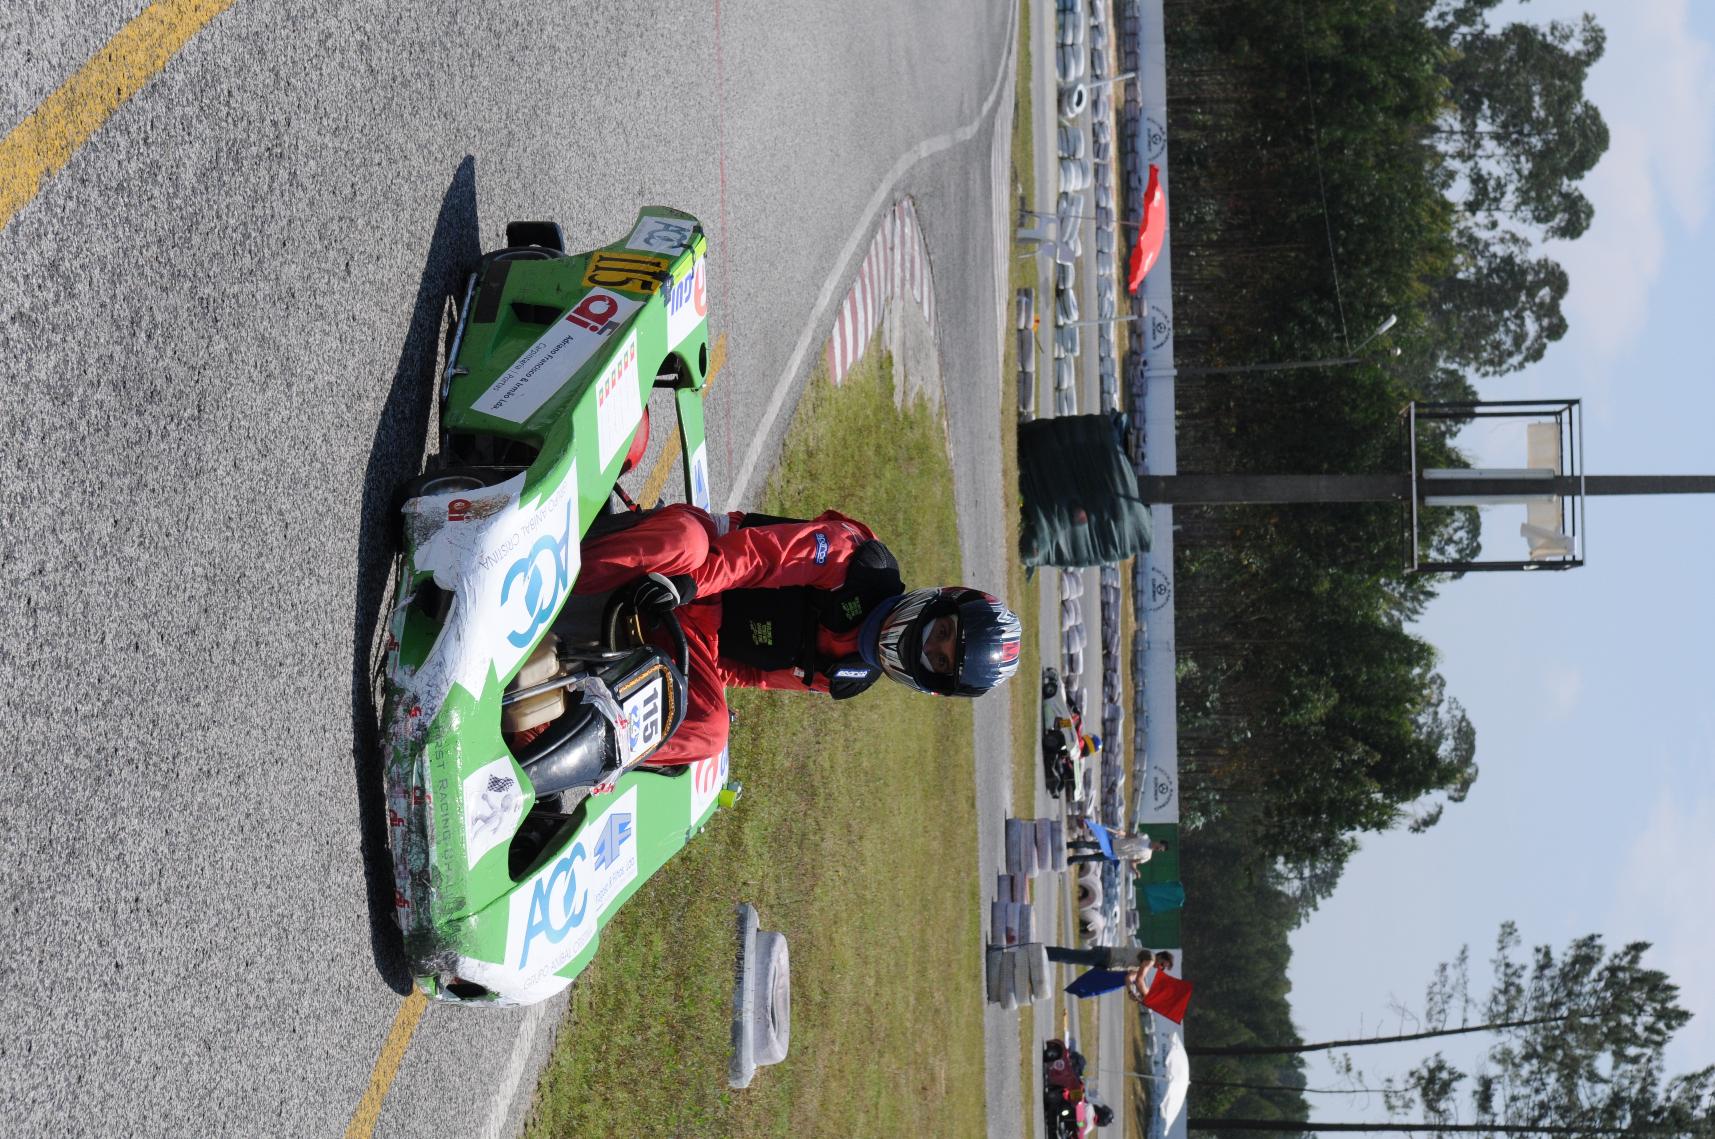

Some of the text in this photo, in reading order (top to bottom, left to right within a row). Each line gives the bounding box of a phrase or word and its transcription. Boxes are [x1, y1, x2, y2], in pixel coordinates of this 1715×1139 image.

[588, 255, 662, 290] 115
[514, 342, 546, 370] Carpintaria
[550, 334, 574, 355] Adriano
[525, 354, 554, 378] Francisco
[642, 687, 658, 744] 115
